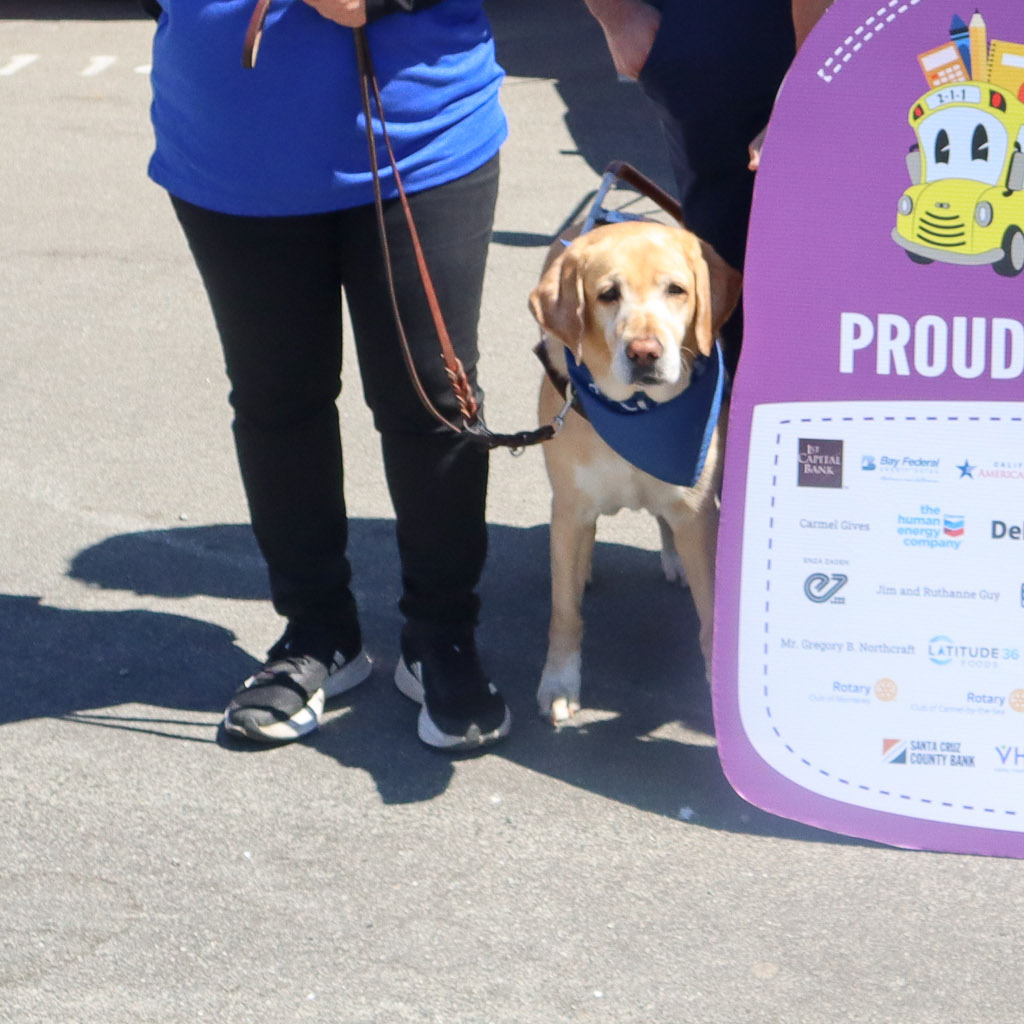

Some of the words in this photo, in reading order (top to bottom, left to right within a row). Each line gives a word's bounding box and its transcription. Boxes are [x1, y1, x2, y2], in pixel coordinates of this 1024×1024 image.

[797, 453, 841, 465] CAPITAL
[880, 456, 898, 468] Bay
[902, 456, 940, 467] Federal
[804, 464, 834, 475] BANK
[920, 504, 941, 515] the
[799, 518, 838, 530] Carmel
[840, 520, 870, 531] Gives
[897, 513, 941, 526] human
[897, 526, 941, 539] energy
[903, 537, 962, 550] company
[876, 585, 897, 595] Jim
[899, 586, 920, 596] and
[923, 587, 976, 599] Ruthanne
[979, 589, 1000, 601] Guy
[781, 637, 799, 649] Mr.
[801, 639, 844, 653] Gregory
[859, 642, 915, 655] Northcraft
[928, 645, 999, 659] LATITUDE
[1002, 648, 1020, 660] 36
[833, 682, 871, 696] Rotary
[967, 692, 1005, 707] Rotary
[910, 740, 937, 752] SANTA
[939, 741, 961, 753] CRUZ
[910, 753, 948, 766] COUNTY
[950, 754, 976, 767] BANK
